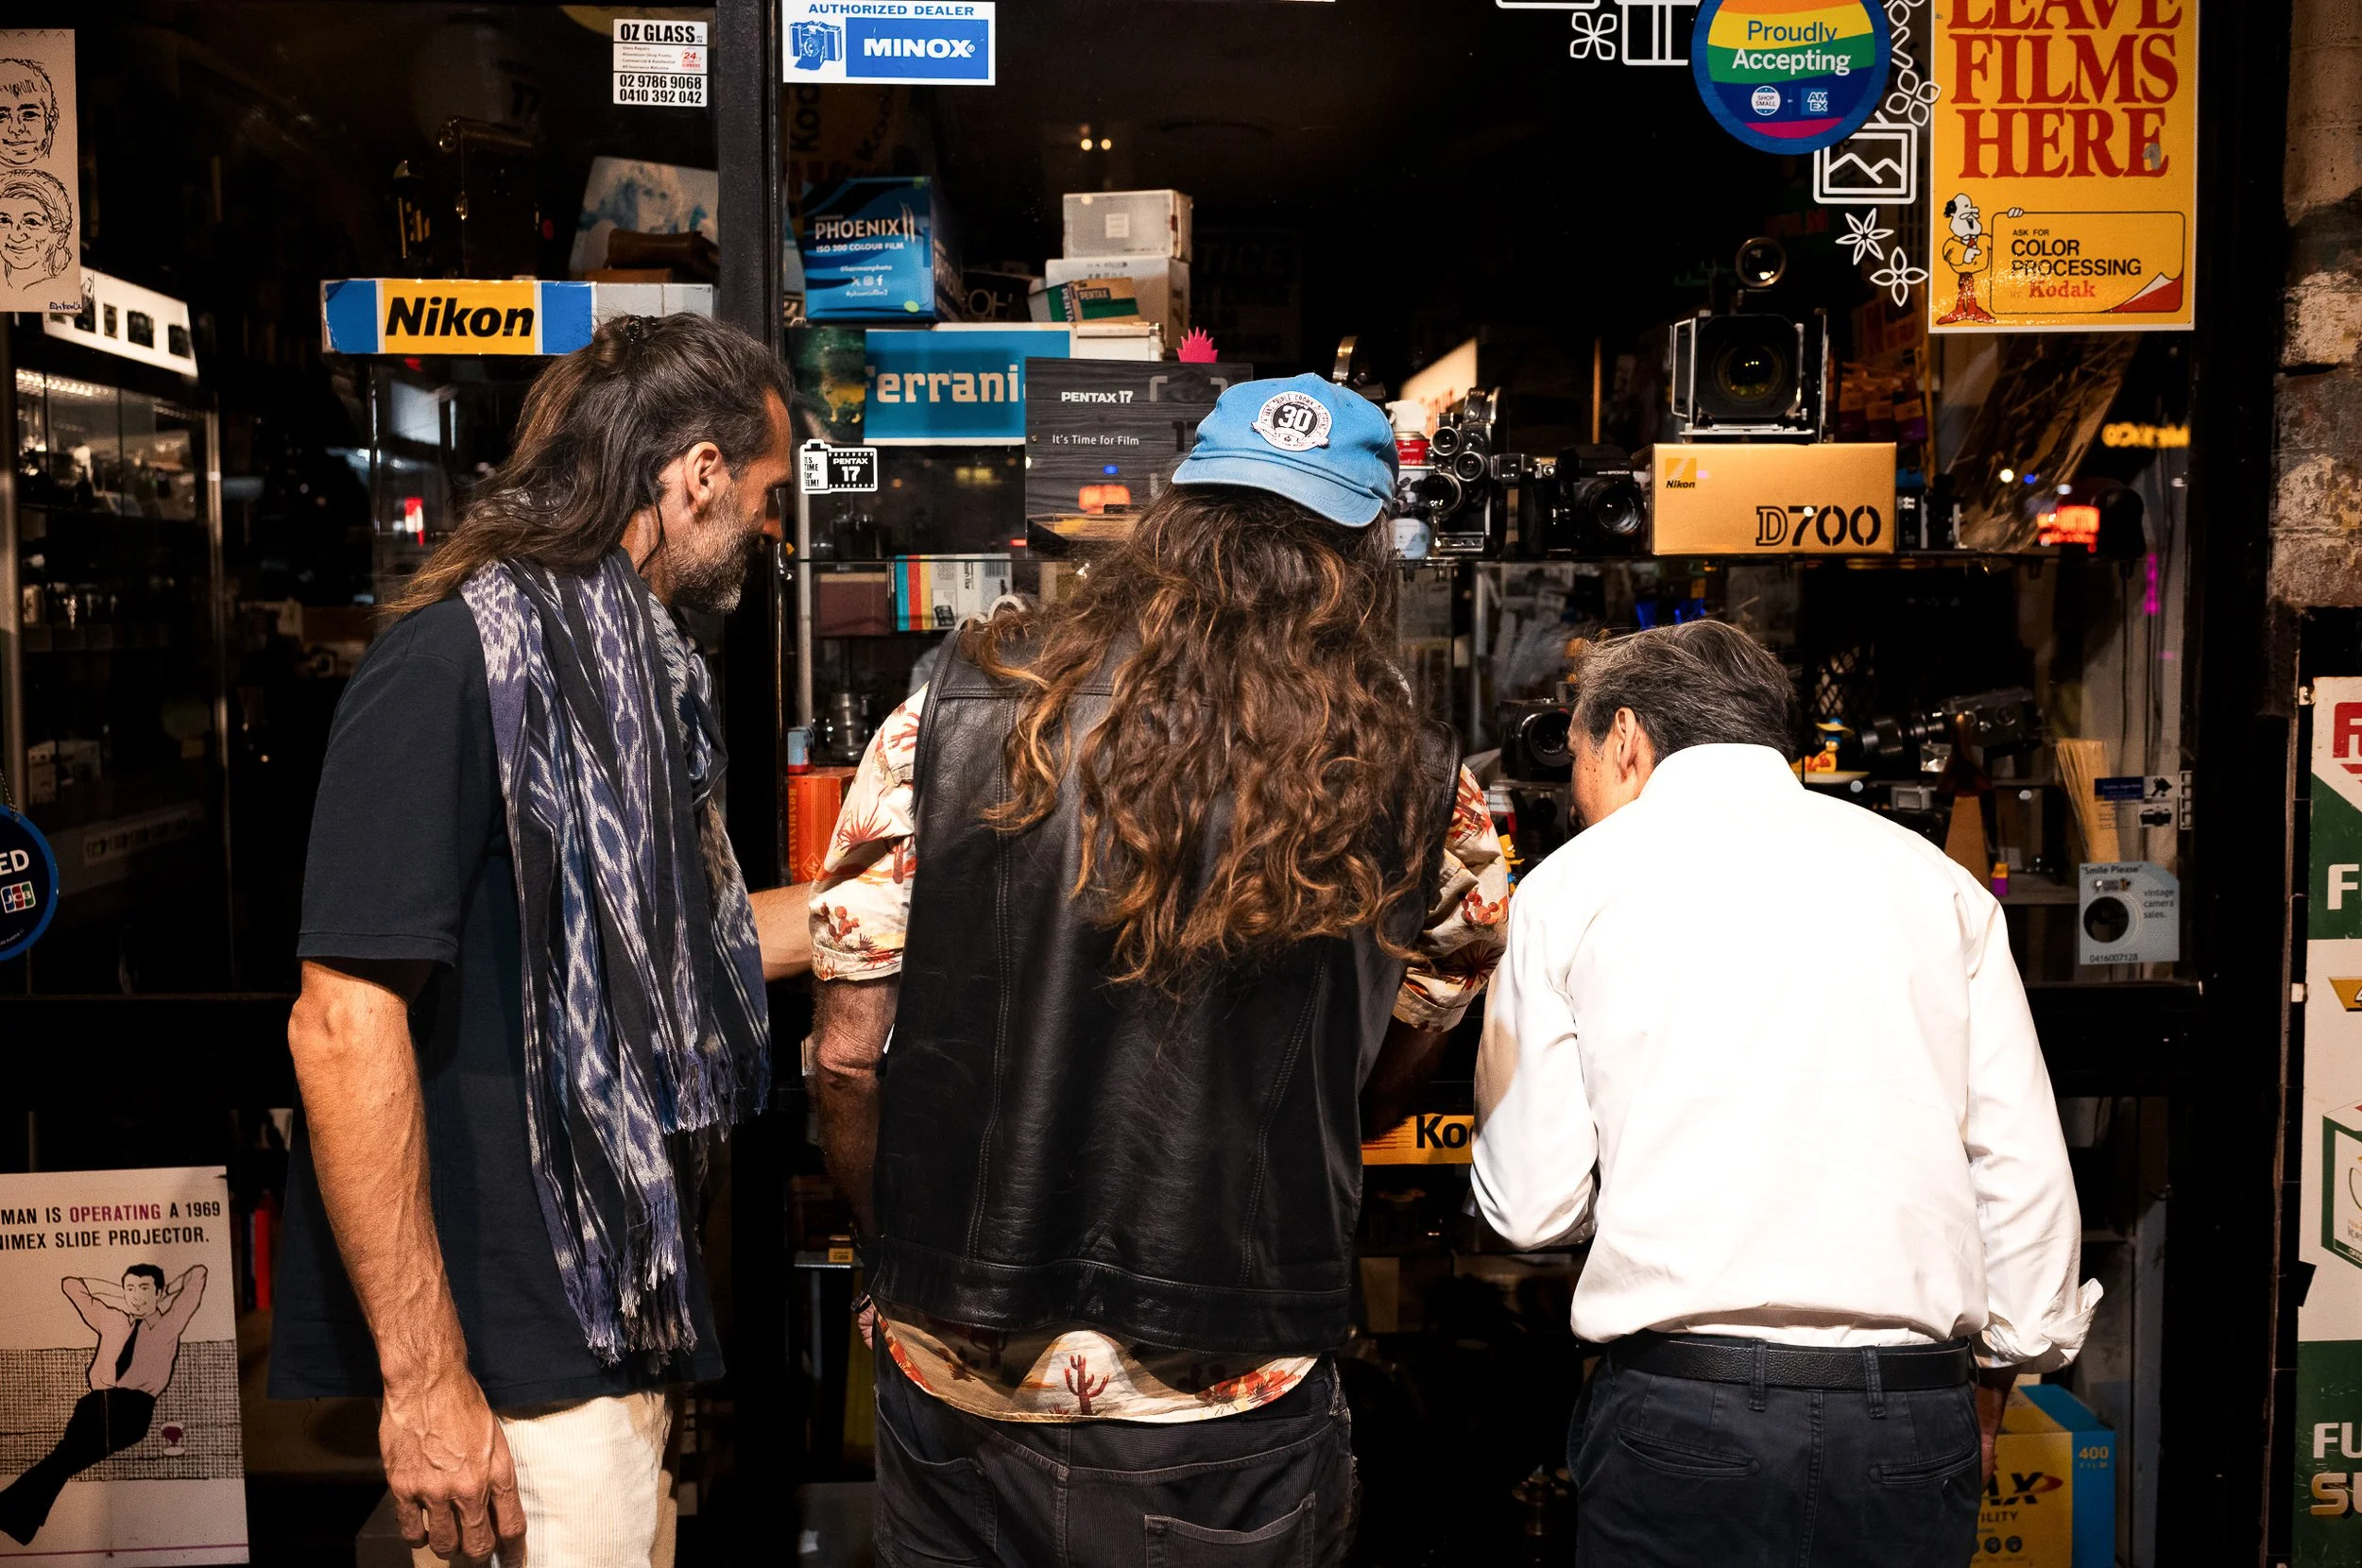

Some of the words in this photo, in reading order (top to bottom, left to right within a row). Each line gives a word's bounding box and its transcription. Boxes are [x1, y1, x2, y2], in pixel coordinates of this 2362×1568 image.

[809, 4, 907, 15] AUTHORIZED
[914, 6, 974, 16] DEALER
[620, 23, 640, 42] OZ
[643, 24, 695, 43] GLASS
[1747, 20, 1838, 47] Proudly
[1732, 48, 1852, 77] Accepting
[1948, 33, 2179, 104] FILMS
[619, 75, 635, 87] 02
[638, 76, 667, 89] 9786
[670, 77, 702, 90] 9068
[619, 89, 649, 102] 0410
[652, 90, 676, 103] 392
[678, 91, 702, 104] 042
[1956, 107, 2170, 179] HERE
[815, 219, 899, 240] PHOENIX
[2012, 229, 2029, 237] ASK
[816, 245, 831, 253] ISO
[848, 243, 883, 252] COLOUR
[884, 242, 905, 250] FILM
[2011, 239, 2080, 257] COLOR
[2011, 258, 2142, 276] PROCESSING
[2029, 280, 2097, 298] Kodak
[385, 296, 535, 338] Nikon
[865, 365, 1026, 403] errani
[1061, 391, 1117, 403] PENTAX
[1119, 390, 1133, 403] 17
[1277, 404, 1313, 432] 30
[1052, 435, 1069, 445] It's
[1071, 435, 1097, 445] Time
[1100, 435, 1114, 445] for
[1117, 435, 1139, 446] Film
[841, 466, 861, 482] 17
[1666, 480, 1696, 489] Nikon
[1755, 504, 1882, 547] D700
[2, 891, 32, 905] JCB
[1415, 1116, 1474, 1149] Ko
[1, 1208, 38, 1225] MAN
[45, 1206, 61, 1223] IS
[69, 1203, 161, 1223] OPERATING
[169, 1202, 180, 1219] A
[186, 1201, 221, 1218] 1969
[55, 1230, 101, 1249] SLIDE
[109, 1226, 210, 1246] PROJECTOR.
[2079, 1446, 2109, 1460] 400
[2310, 1472, 2362, 1516] S
